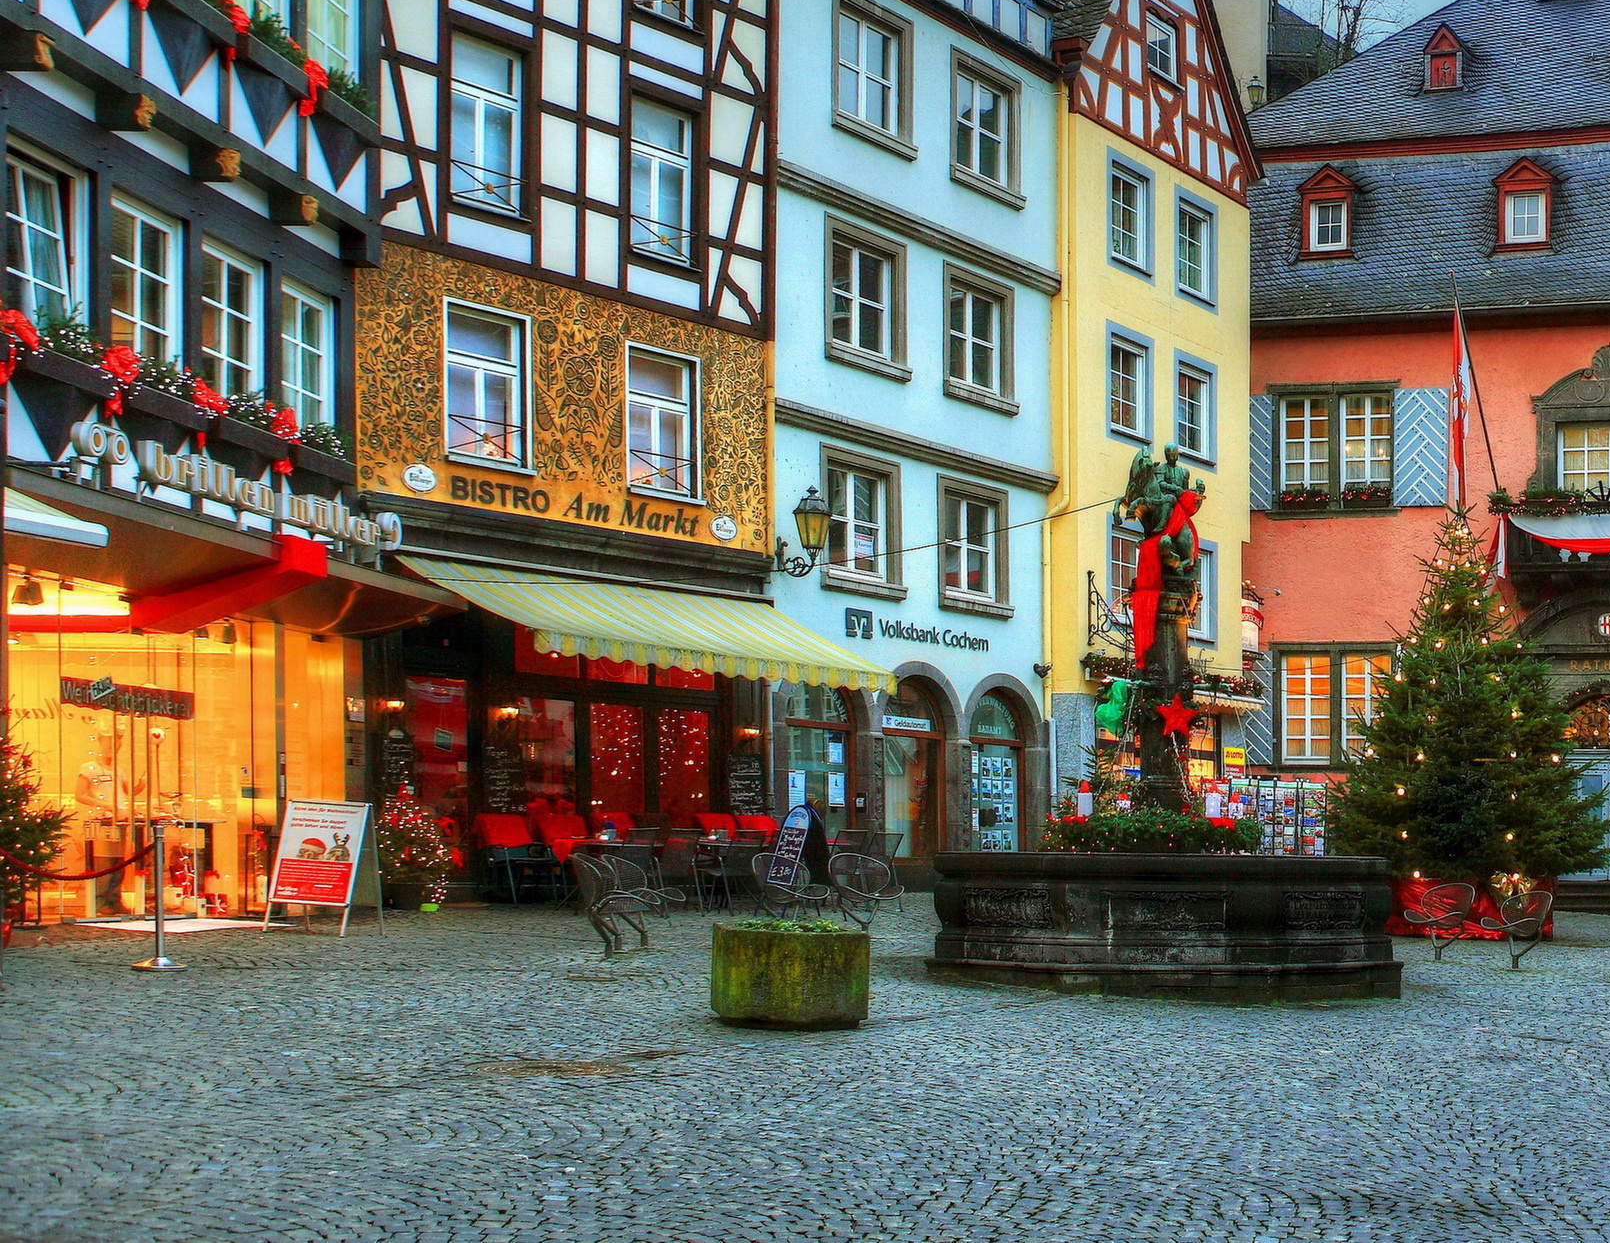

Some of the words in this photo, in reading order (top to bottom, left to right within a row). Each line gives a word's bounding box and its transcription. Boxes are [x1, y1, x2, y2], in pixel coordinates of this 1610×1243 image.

[145, 440, 276, 514] brillen
[284, 493, 382, 546] müller
[450, 474, 550, 513] BISTRO
[563, 491, 611, 524] Am
[619, 499, 700, 537] Markt
[879, 618, 940, 645] Volksbank
[942, 629, 989, 652] Cochem
